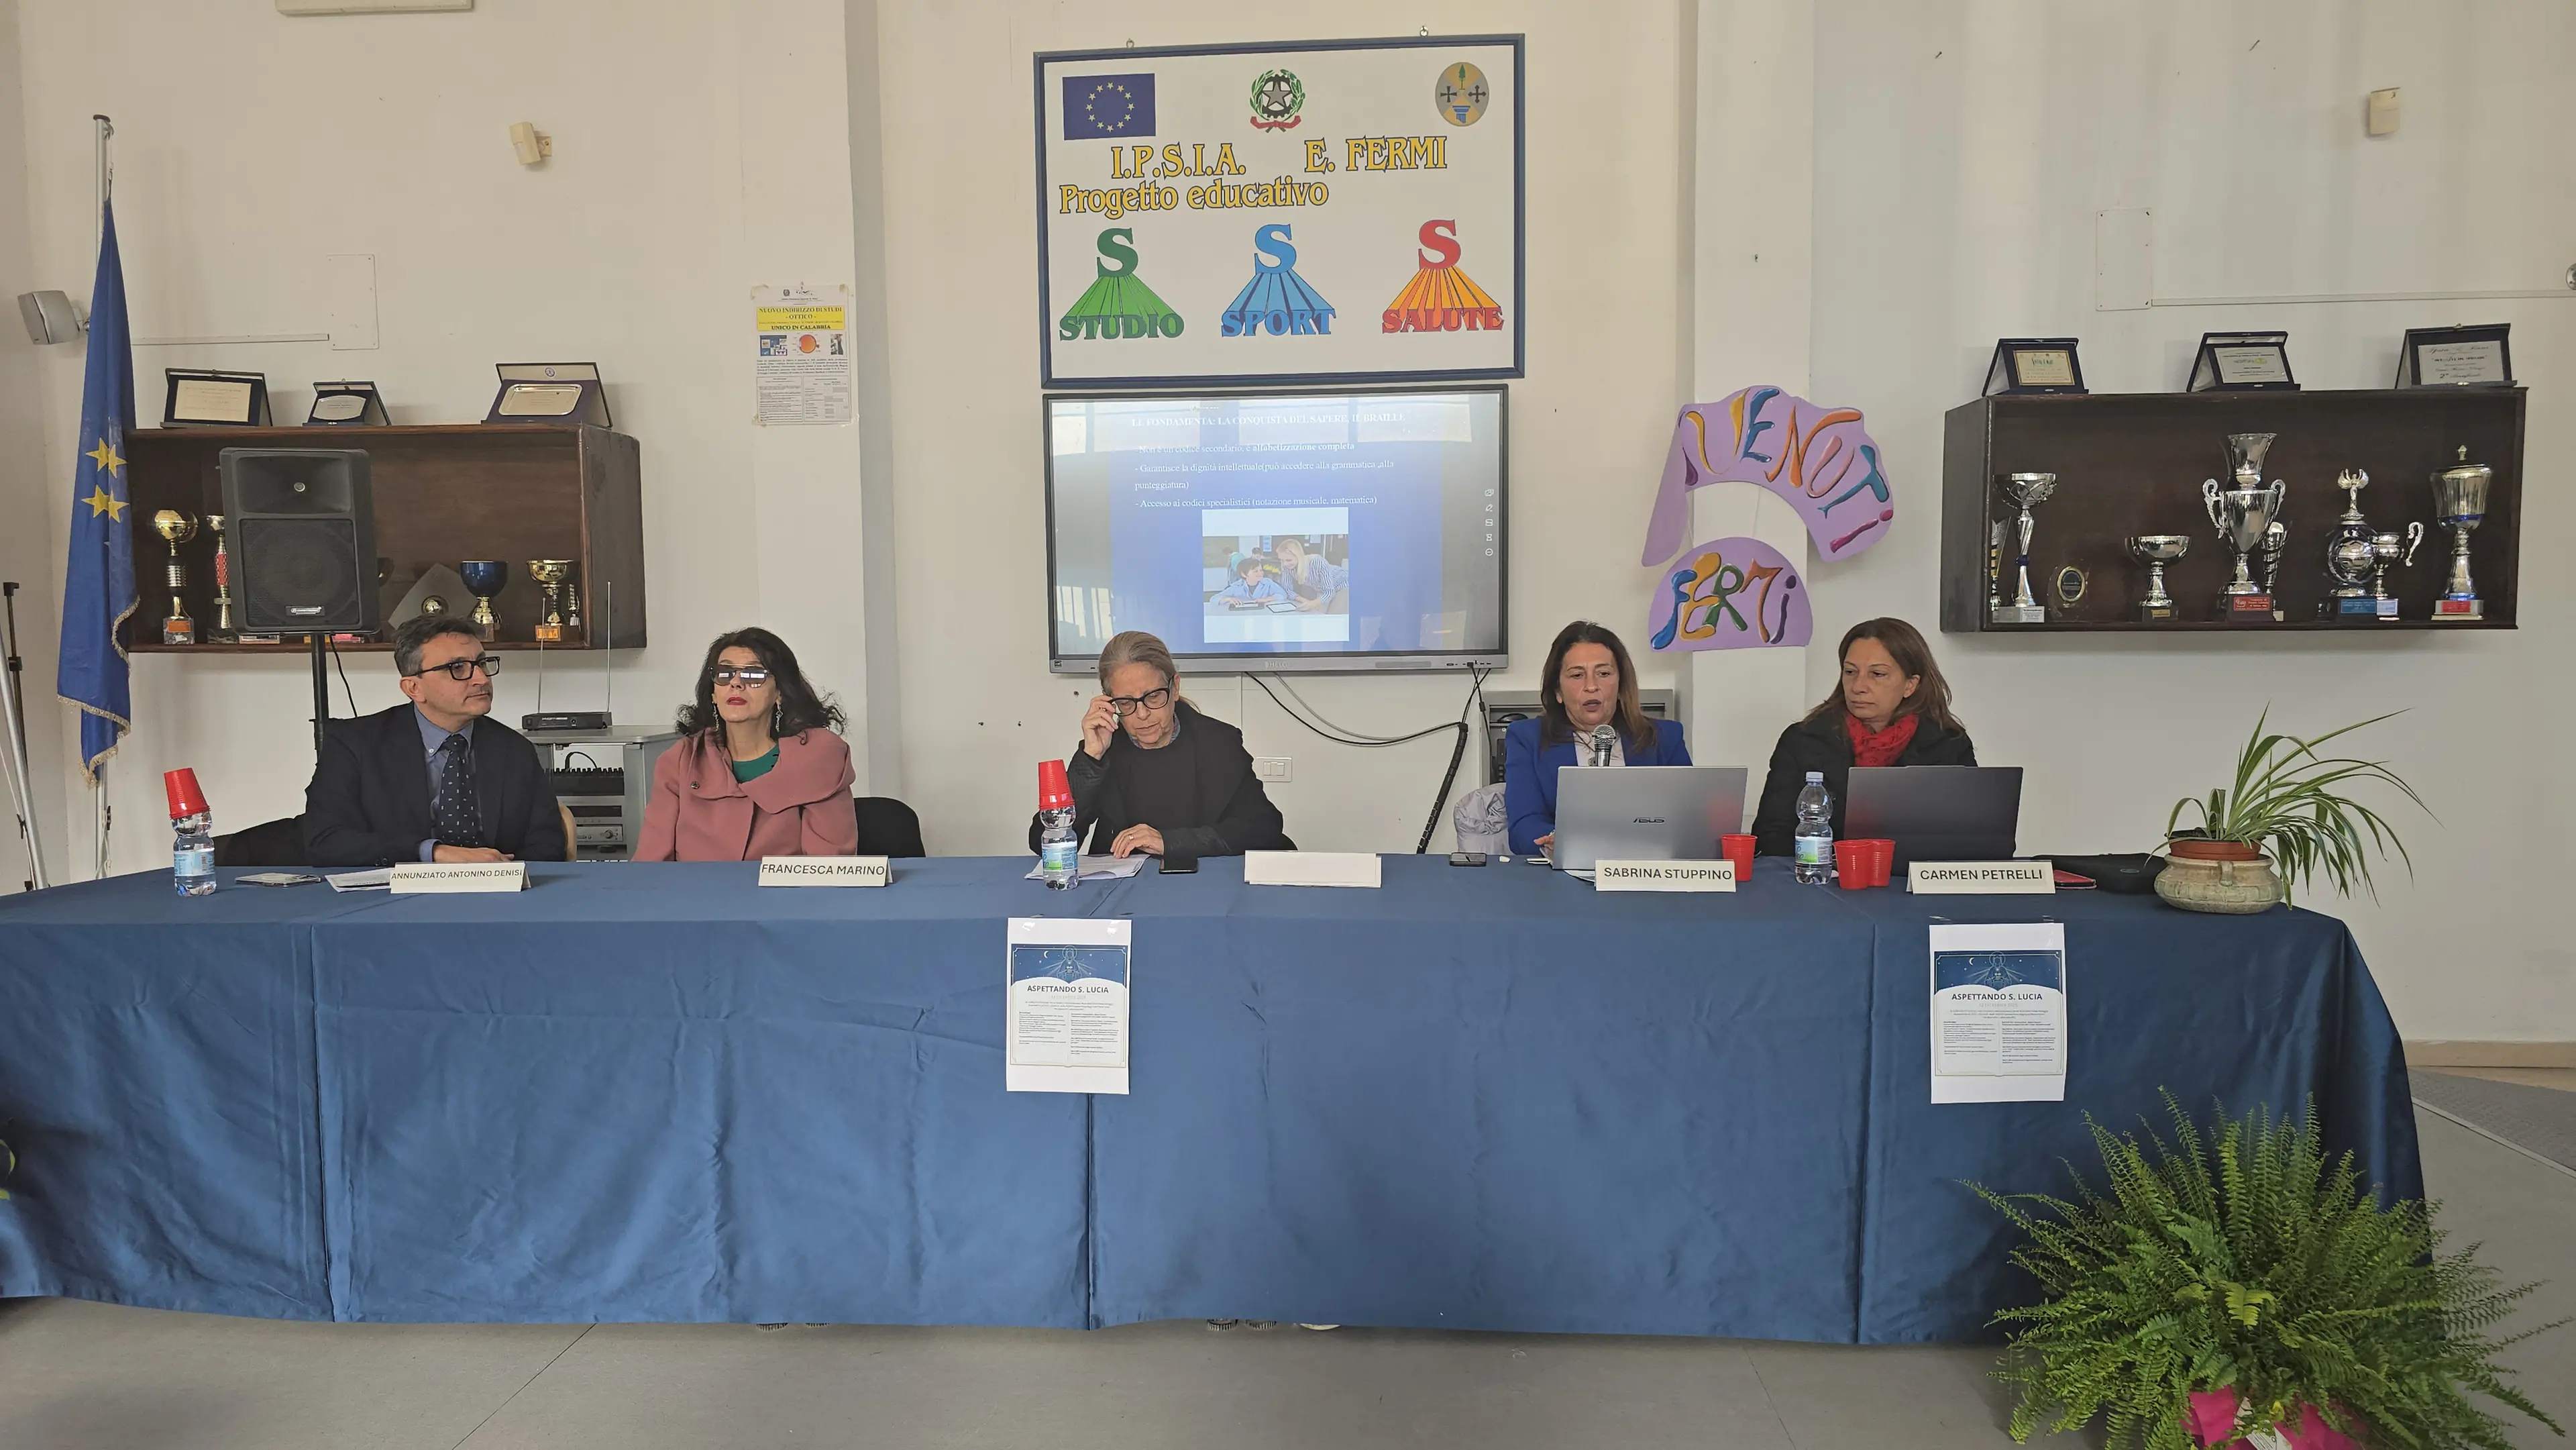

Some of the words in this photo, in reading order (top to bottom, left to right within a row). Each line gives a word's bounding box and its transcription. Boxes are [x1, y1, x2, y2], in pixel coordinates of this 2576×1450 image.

[1111, 142, 1246, 179] I.P.S.I.A.
[1305, 138, 1336, 173] E.
[1346, 135, 1448, 172] FERMI
[1060, 179, 1179, 219] Progetto
[1187, 176, 1329, 209] educativo
[1254, 223, 1297, 274] S
[1417, 219, 1462, 269] S
[1097, 227, 1139, 278] S
[1221, 308, 1337, 338] SPORT
[1382, 306, 1505, 334] SALUTE
[1059, 312, 1185, 342] STUDIO
[1132, 418, 1144, 427] LE
[1218, 417, 1231, 425] LA
[1232, 415, 1287, 425] CONQUISTA
[1290, 415, 1308, 423] DEL
[1352, 414, 1360, 423] IL
[1139, 446, 1155, 454] Non
[1175, 445, 1200, 454] codice
[1253, 443, 1317, 452] alfabetizzazione
[1318, 443, 1354, 452] completa
[1140, 464, 1181, 472] Garantisce
[1182, 464, 1189, 472] la
[1190, 464, 1216, 474] dignità
[1281, 462, 1314, 470] accedere
[1316, 461, 1330, 470] alla
[1331, 461, 1376, 472] grammatica
[1134, 481, 1189, 491] punteggiatura)
[1140, 499, 1171, 508] Accesso
[1173, 499, 1181, 507] ai
[1182, 498, 1205, 507] codici
[1207, 497, 1251, 509] specialistici
[1252, 497, 1291, 507] (notazione
[1293, 496, 1329, 506] musicale,
[1331, 496, 1377, 505] matematica)
[391, 871, 446, 880] ANNUNZIATO
[447, 870, 493, 878] ANTONINO
[494, 869, 523, 877] DENISI
[761, 864, 834, 875] FRANCESCA
[836, 865, 885, 876] MARINO
[1603, 867, 1662, 878] SABRINA
[1664, 869, 1732, 880] STUPPINO
[1920, 870, 1978, 880] CARMEN
[1982, 869, 2043, 880] PETRELLI
